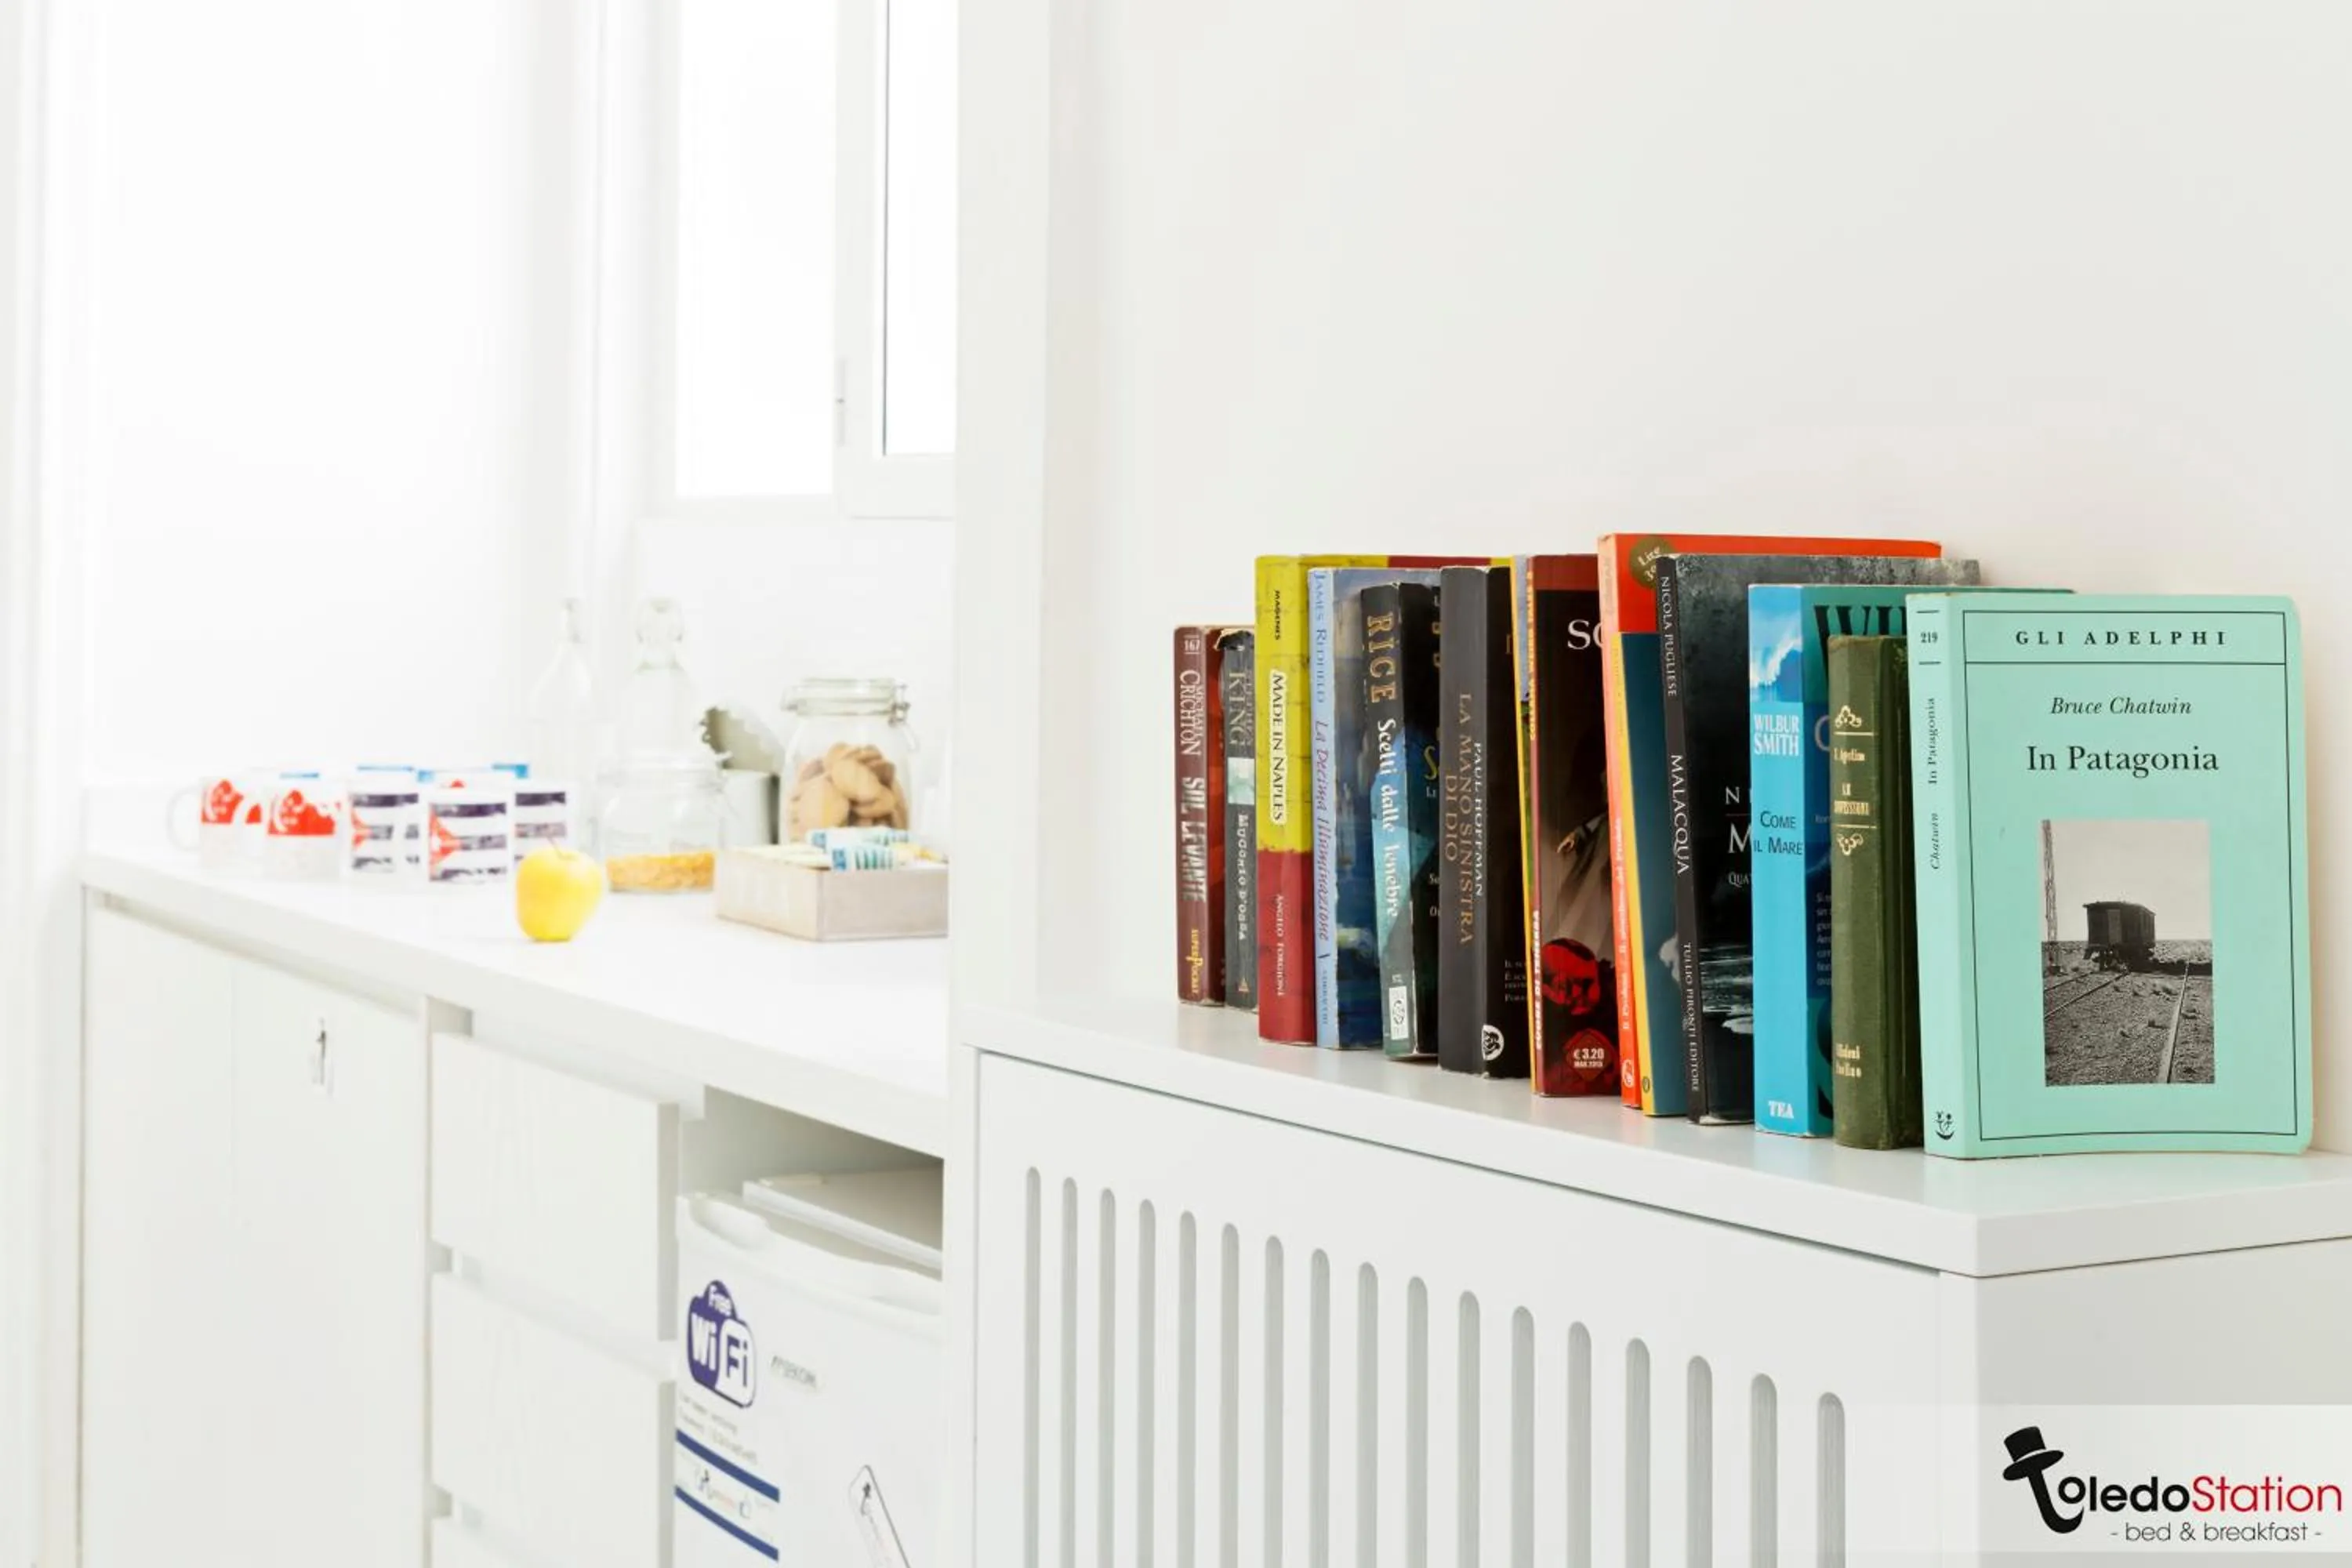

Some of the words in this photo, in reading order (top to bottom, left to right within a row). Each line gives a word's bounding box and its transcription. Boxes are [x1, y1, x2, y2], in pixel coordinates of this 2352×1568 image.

[1661, 576, 1672, 630] NICOLA
[1367, 612, 1397, 703] RICE
[1921, 632, 1938, 643] 219
[2016, 631, 2065, 644] GLI
[2084, 631, 2227, 645] ADELPHI
[1664, 633, 1677, 697] PUGLIESE
[1179, 670, 1202, 757] CRICHTON
[1229, 672, 1246, 746] KING
[1273, 674, 1284, 727] MADE
[1460, 693, 1472, 724] LA
[1753, 714, 1800, 733] WILBUR
[2050, 697, 2103, 714] Bruce
[2109, 696, 2194, 714] Chatwin
[1273, 732, 1283, 750] IN
[1316, 720, 1329, 742] La
[1377, 718, 1399, 775] Scelti
[1754, 733, 1799, 757] SMITH
[1926, 698, 1940, 765] Patagonia
[1273, 757, 1285, 822] NAPLES
[1316, 750, 1330, 811] Decima
[1446, 775, 1457, 800] DI
[1460, 735, 1472, 815] MANO
[1928, 771, 1937, 784] In
[2027, 746, 2056, 771] In
[2067, 746, 2220, 779] Patagonia
[1181, 777, 1206, 815] SOL
[1381, 785, 1399, 833] dalle
[1671, 755, 1690, 874] MALACQUA
[1181, 821, 1207, 902] LEVANTE
[1445, 813, 1458, 862] DIO
[1930, 813, 1940, 869] Chatwin
[1317, 818, 1332, 941] Illuminazione
[1384, 844, 1402, 917] tenebre
[1460, 824, 1473, 945] SINISTRA
[1683, 942, 1693, 985] TULLIO
[1690, 1042, 1700, 1091] EDITORE
[1768, 1101, 1794, 1120] TEA
